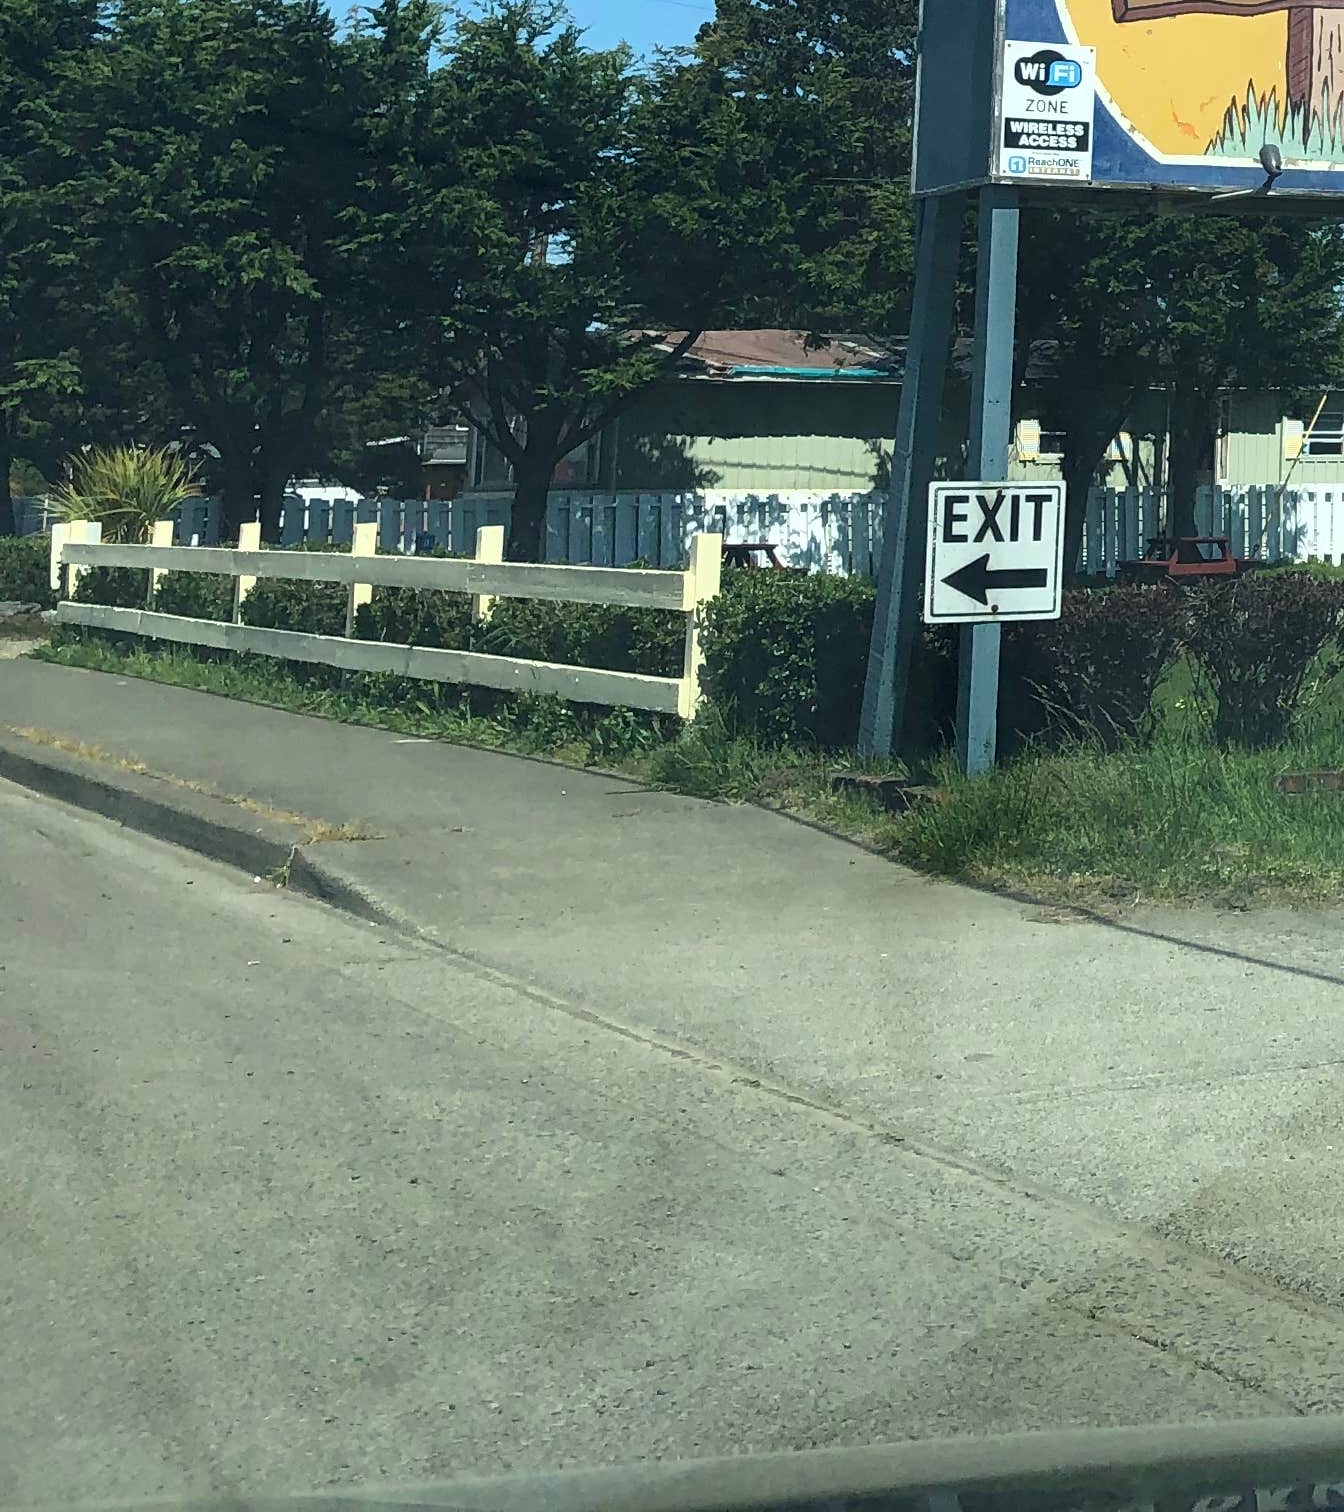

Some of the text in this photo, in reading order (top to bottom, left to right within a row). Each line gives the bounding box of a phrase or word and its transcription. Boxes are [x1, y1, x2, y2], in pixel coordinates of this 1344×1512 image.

[1025, 99, 1069, 114] ZONE
[1010, 121, 1084, 136] WIRELESS
[1019, 134, 1077, 148] ACCESS
[943, 495, 1052, 542] EXIT
